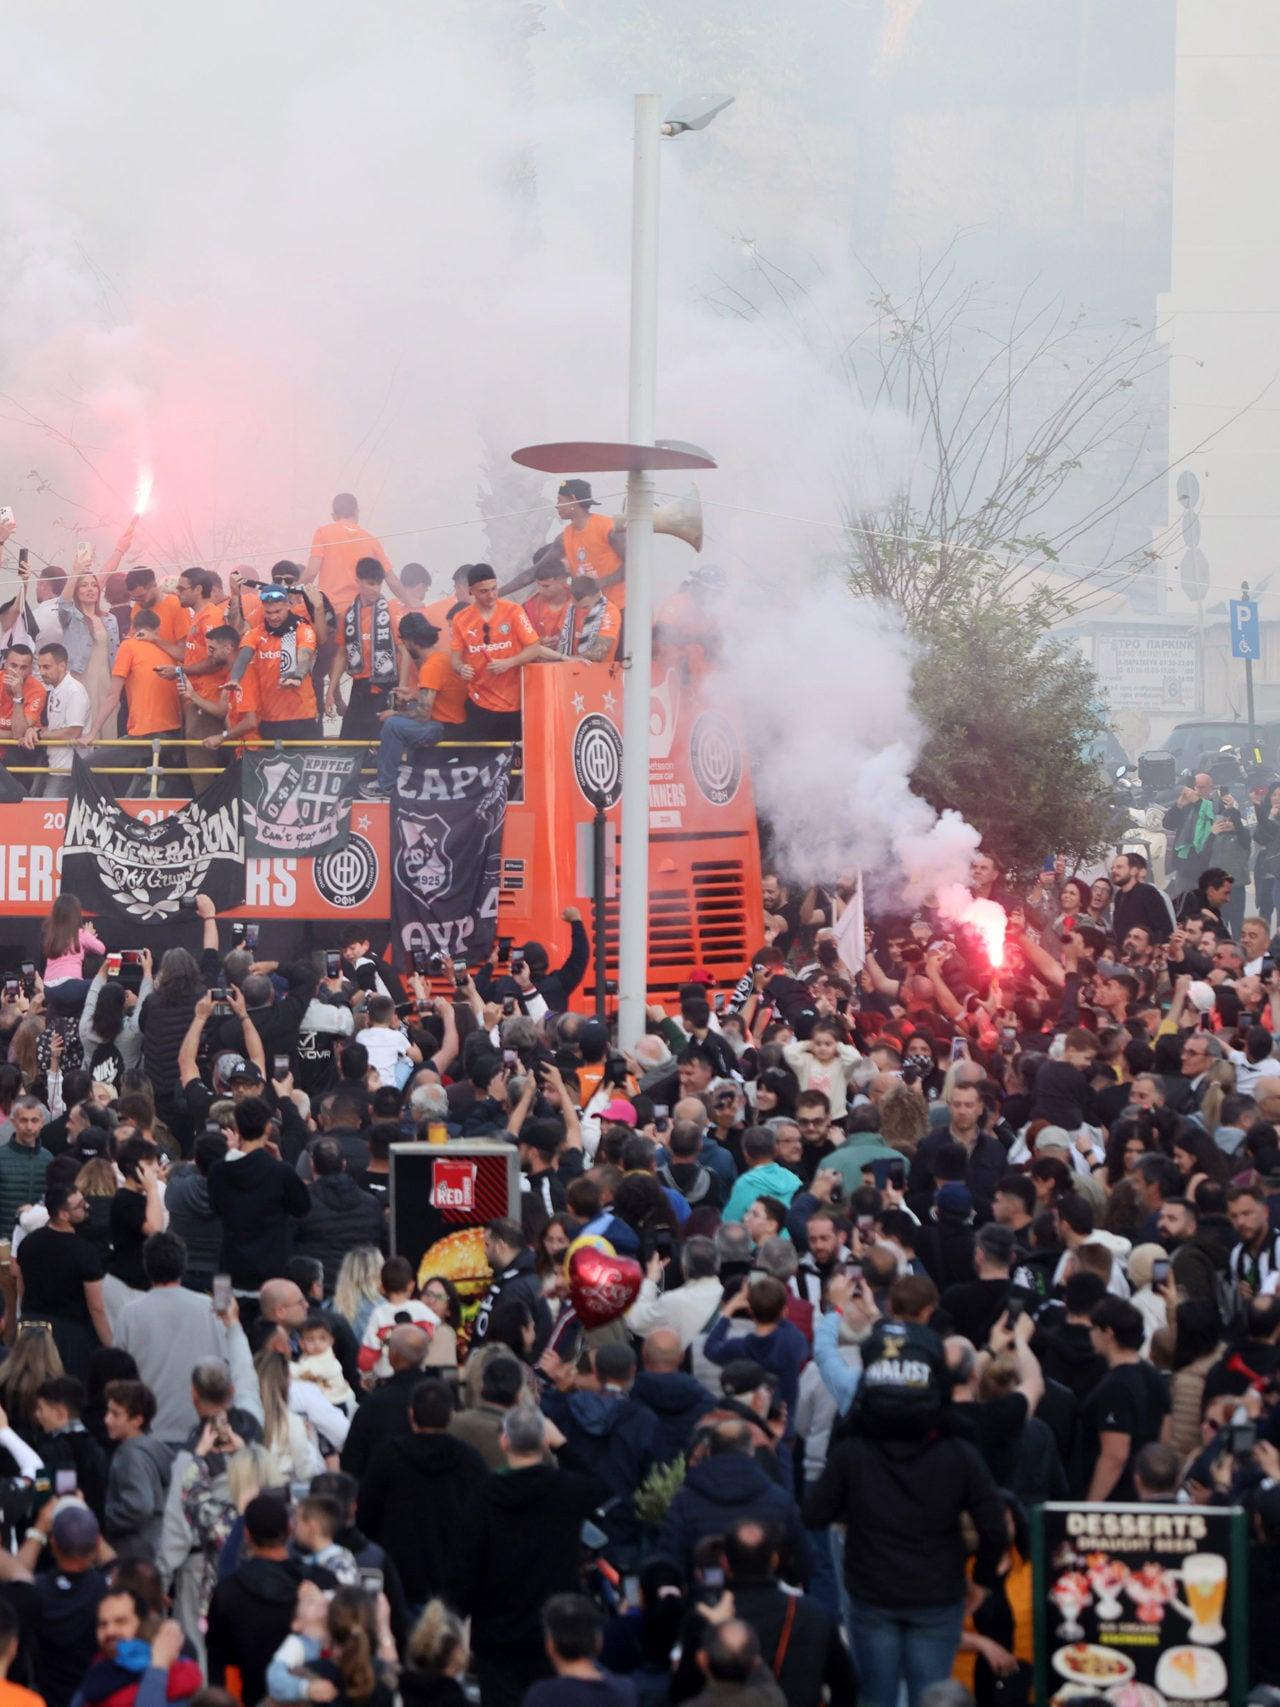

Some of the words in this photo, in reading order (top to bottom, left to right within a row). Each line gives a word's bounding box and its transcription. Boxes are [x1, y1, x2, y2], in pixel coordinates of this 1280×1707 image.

[1237, 605, 1251, 630] P
[307, 774, 317, 790] 2
[331, 776, 341, 794] 0
[43, 812, 65, 830] 20
[421, 875, 441, 886] 925
[1066, 1512, 1208, 1539] DESSERTS
